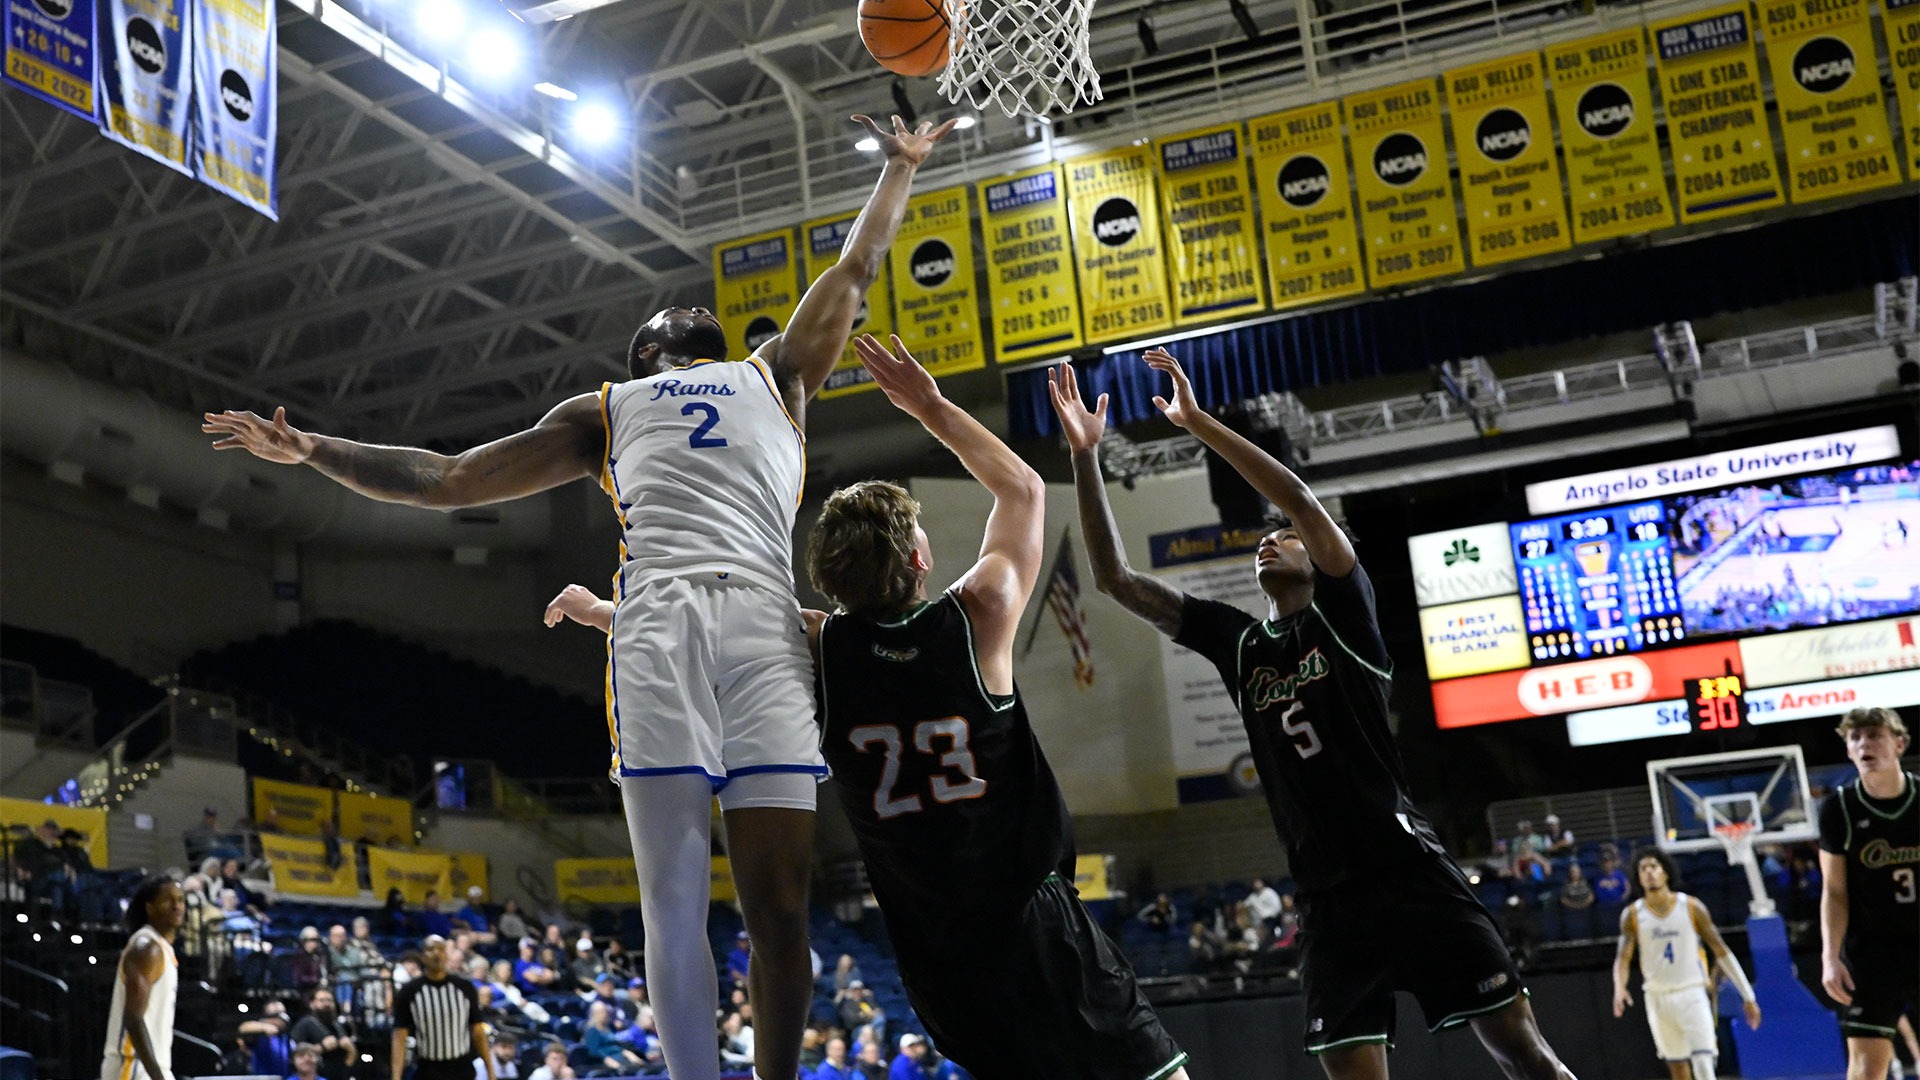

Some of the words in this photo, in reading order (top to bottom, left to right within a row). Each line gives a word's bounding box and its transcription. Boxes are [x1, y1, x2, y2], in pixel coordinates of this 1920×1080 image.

[1768, 4, 1796, 24] ASU
[1661, 28, 1688, 46] ASU
[1665, 34, 1742, 57] BASKETBALL
[129, 36, 166, 68] NCAA
[1555, 54, 1581, 71] ASU
[1670, 69, 1706, 95] LONE
[1711, 61, 1748, 85] STAR
[1801, 58, 1854, 84] NCAA
[1454, 76, 1479, 93] ASU
[221, 86, 253, 115] NCAA
[1353, 101, 1377, 119] ASU
[1668, 83, 1758, 118] CONFERENCE
[1584, 103, 1633, 129] NCAA
[1680, 108, 1755, 139] CHAMPION
[1257, 125, 1281, 142] ASU
[1482, 128, 1531, 152] NCAA
[1165, 142, 1188, 158] ASU
[1074, 164, 1096, 182] ASU
[1380, 153, 1427, 177] NCAA
[988, 182, 1011, 200] ASU
[1207, 176, 1238, 195] STAR
[1284, 174, 1330, 198] NCAA
[995, 223, 1022, 244] LONE
[1026, 216, 1055, 236] STAR
[1097, 215, 1140, 238] NCAA
[993, 235, 1062, 264] CONFERENCE
[914, 257, 954, 279] NCAA
[650, 379, 736, 401] Rams
[681, 402, 728, 449] 2
[1565, 474, 1648, 504] Angelo
[1657, 464, 1718, 487] State
[1727, 440, 1857, 475] University
[1447, 613, 1496, 628] FIRST
[1429, 624, 1520, 644] FINANCIAL
[1246, 646, 1330, 712] Comets
[1780, 687, 1857, 711] Arena
[1696, 695, 1740, 731] 30
[1281, 701, 1322, 760] 5
[848, 715, 988, 819] 23
[1893, 867, 1917, 904] 3
[1664, 942, 1674, 964] 4
